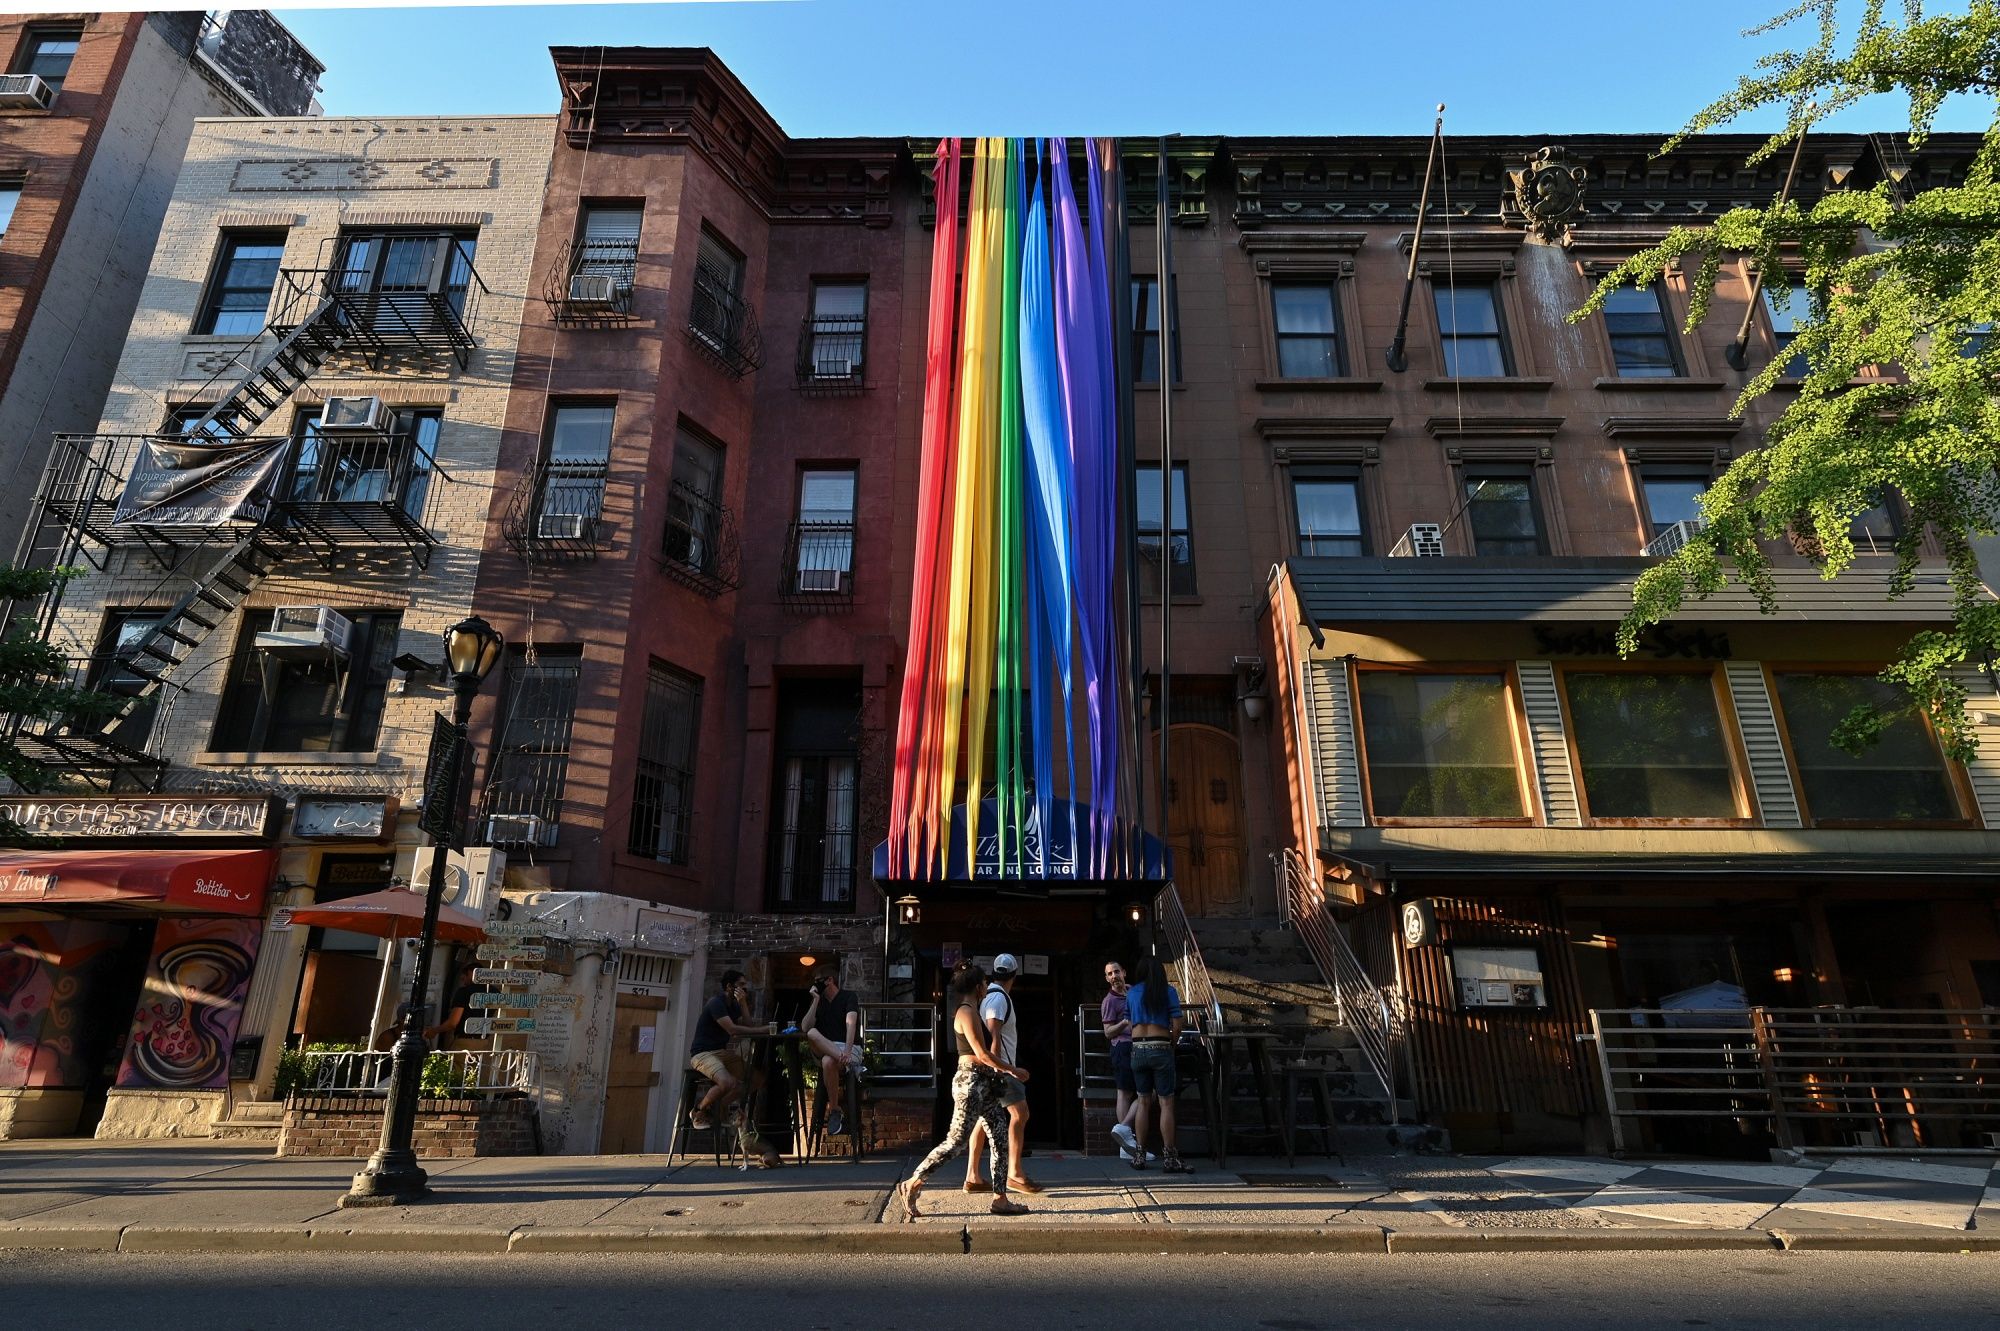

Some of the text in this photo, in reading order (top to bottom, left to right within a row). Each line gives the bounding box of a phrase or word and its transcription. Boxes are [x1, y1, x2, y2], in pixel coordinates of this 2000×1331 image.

[134, 472, 187, 482] HOURGLASS
[973, 865, 993, 875] AR
[12, 869, 59, 892] Tavern
[193, 878, 231, 898] Bettibar
[631, 987, 650, 997] 371
